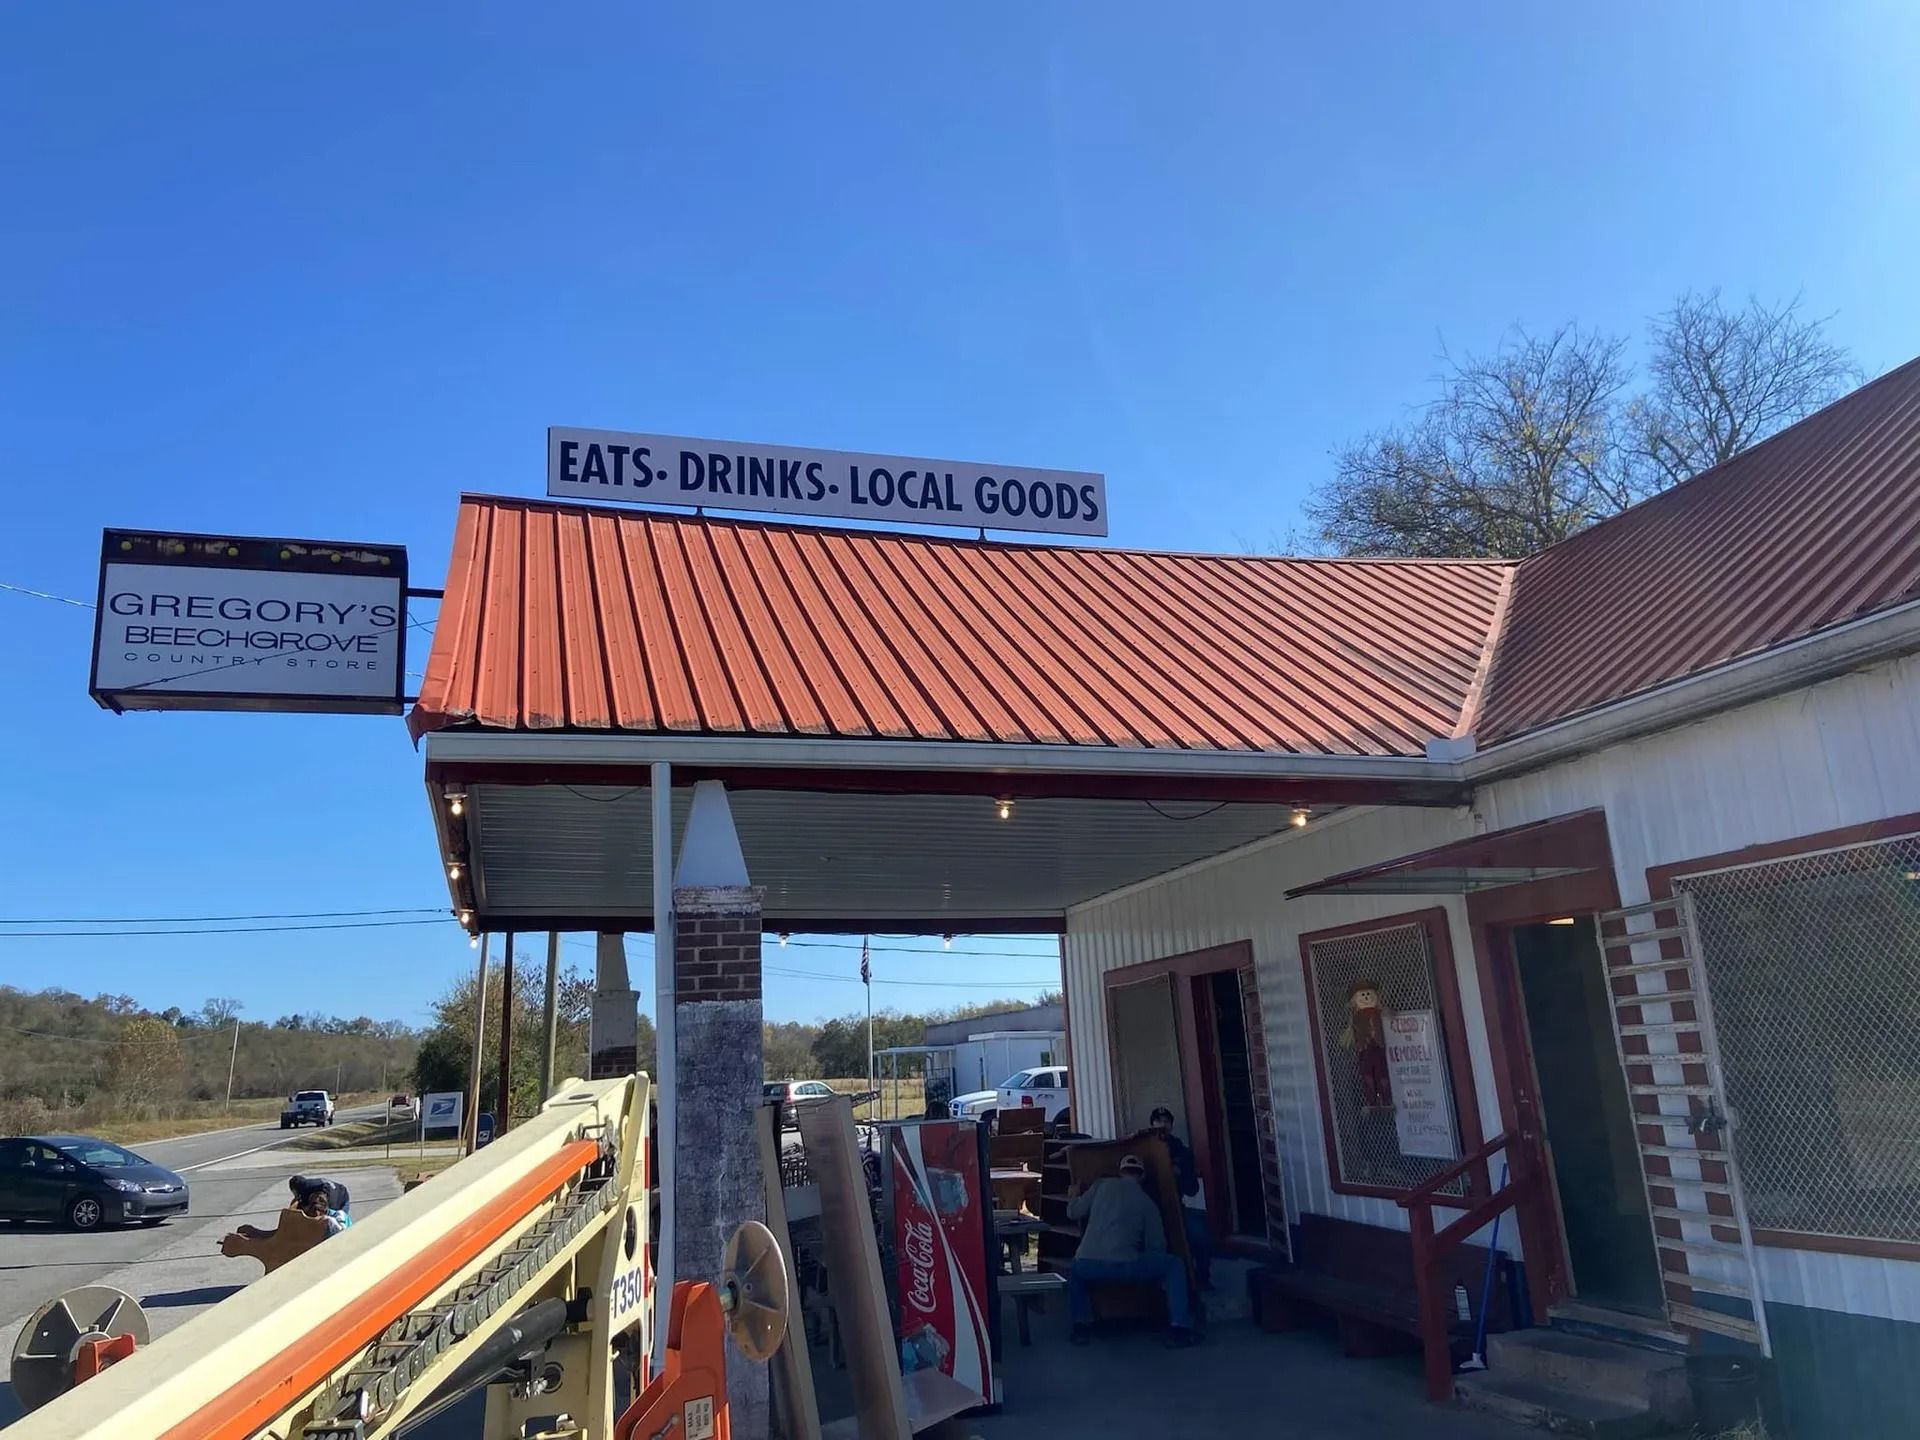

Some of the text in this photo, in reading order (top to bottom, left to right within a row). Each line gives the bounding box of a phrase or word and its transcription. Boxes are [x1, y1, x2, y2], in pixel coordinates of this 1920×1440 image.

[850, 466, 963, 511] LOCAL
[974, 476, 1099, 521] GOODS
[110, 593, 396, 627] GREGORY'S
[125, 625, 379, 653] BEECHGROVE
[124, 652, 377, 670] COUNTRY STORE
[613, 1267, 642, 1319] T350
